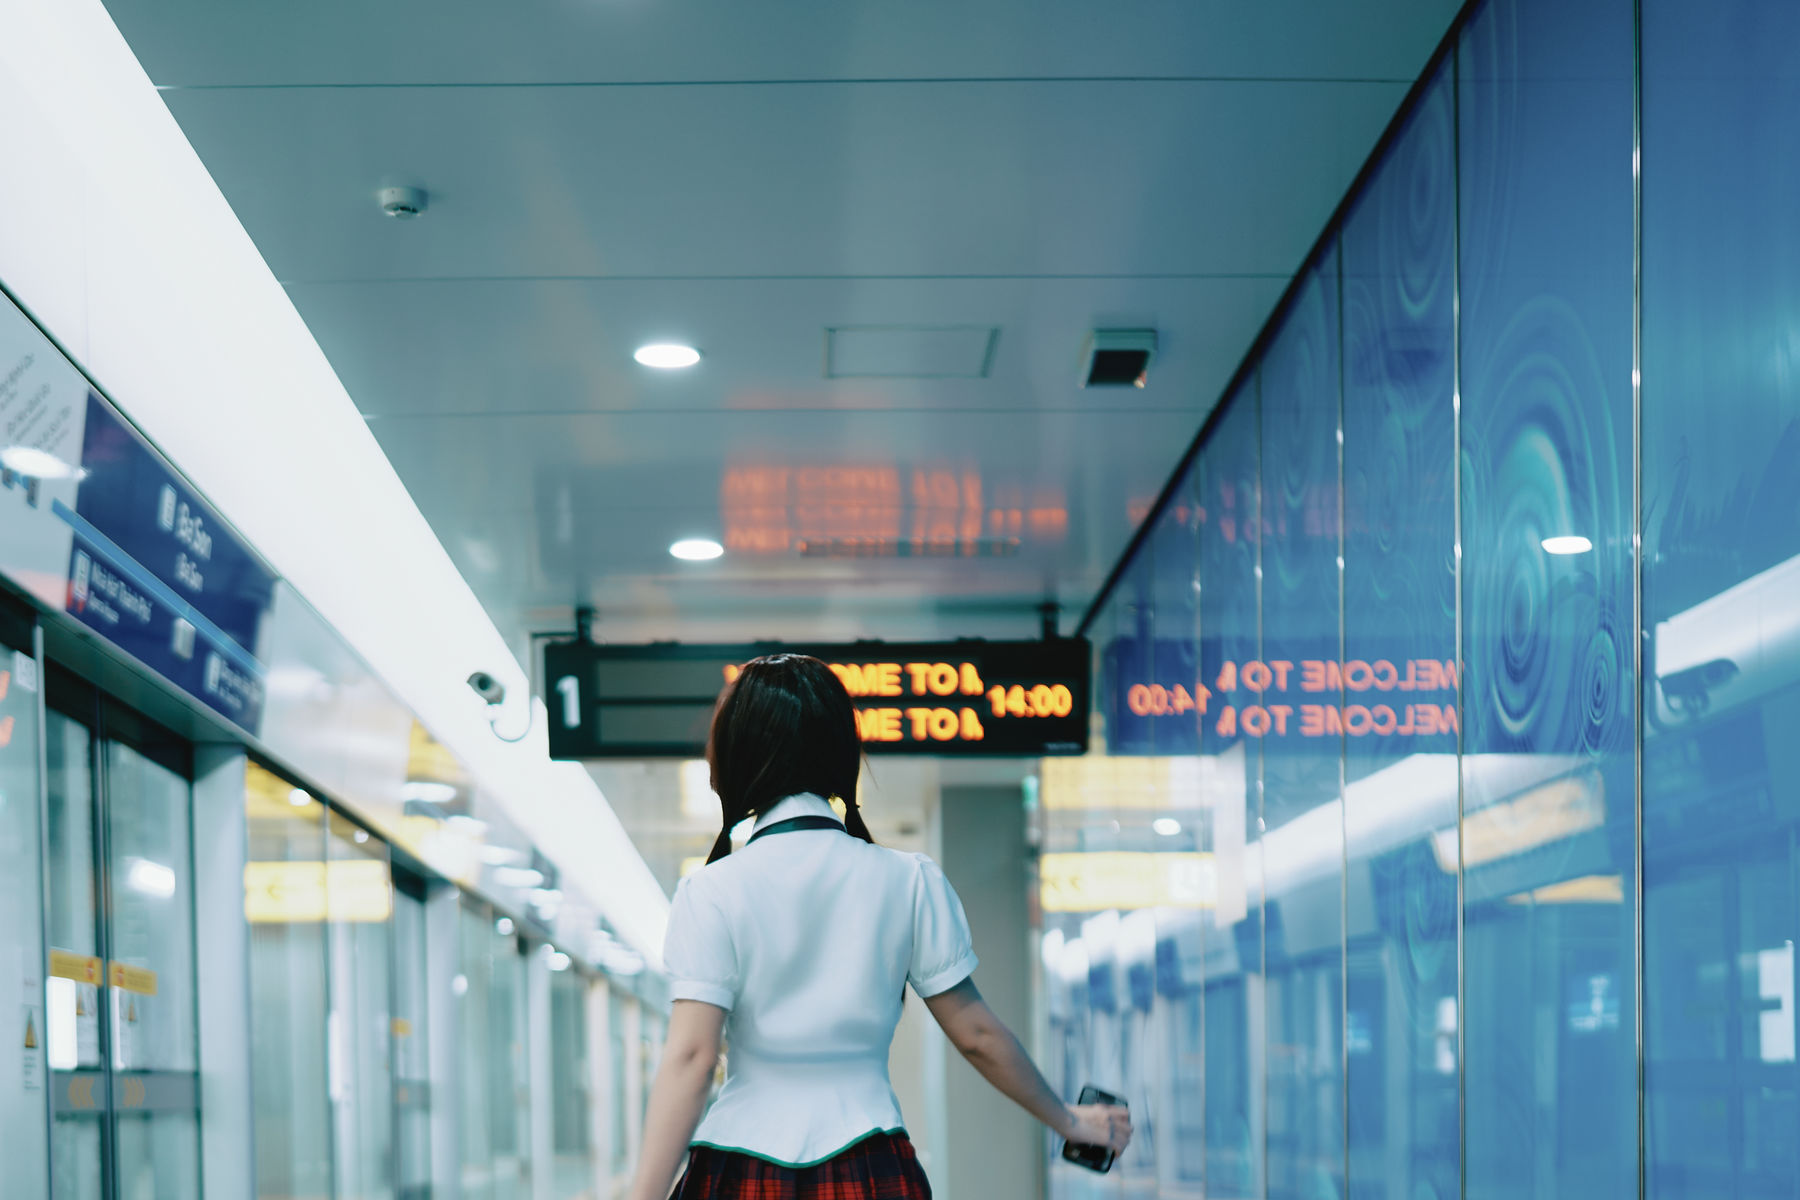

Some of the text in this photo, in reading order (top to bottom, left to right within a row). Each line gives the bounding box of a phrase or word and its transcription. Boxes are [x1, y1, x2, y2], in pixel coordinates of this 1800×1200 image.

[904, 663, 959, 697] TO
[555, 674, 582, 729] 1
[985, 684, 1073, 718] 14:00
[904, 707, 959, 742] TO
